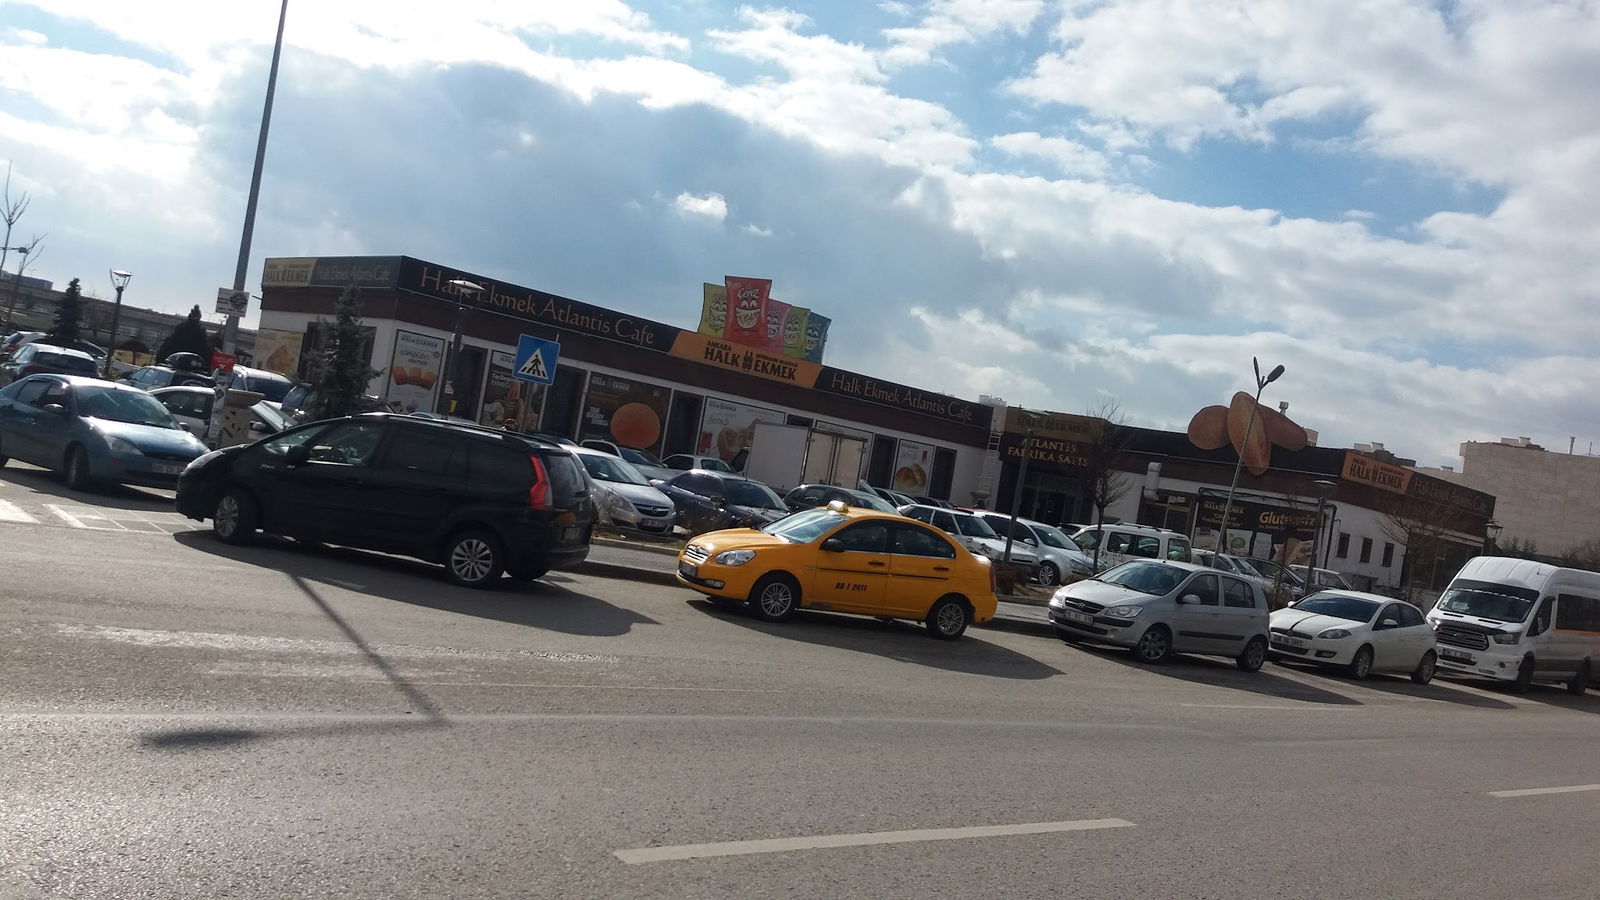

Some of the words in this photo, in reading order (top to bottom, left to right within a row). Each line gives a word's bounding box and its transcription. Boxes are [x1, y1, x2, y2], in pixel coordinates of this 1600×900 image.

[476, 281, 536, 314] Ekmek
[537, 298, 610, 333] Atlantis
[615, 318, 655, 344] Cafe
[704, 346, 740, 368] HALK
[754, 360, 798, 380] EKMEK
[832, 372, 861, 394] Halk
[864, 380, 900, 404] Ekmek
[903, 390, 945, 414] Atlantis
[947, 402, 973, 422] Cafe
[1349, 463, 1371, 480] HALK
[1378, 473, 1402, 489] EKMEK
